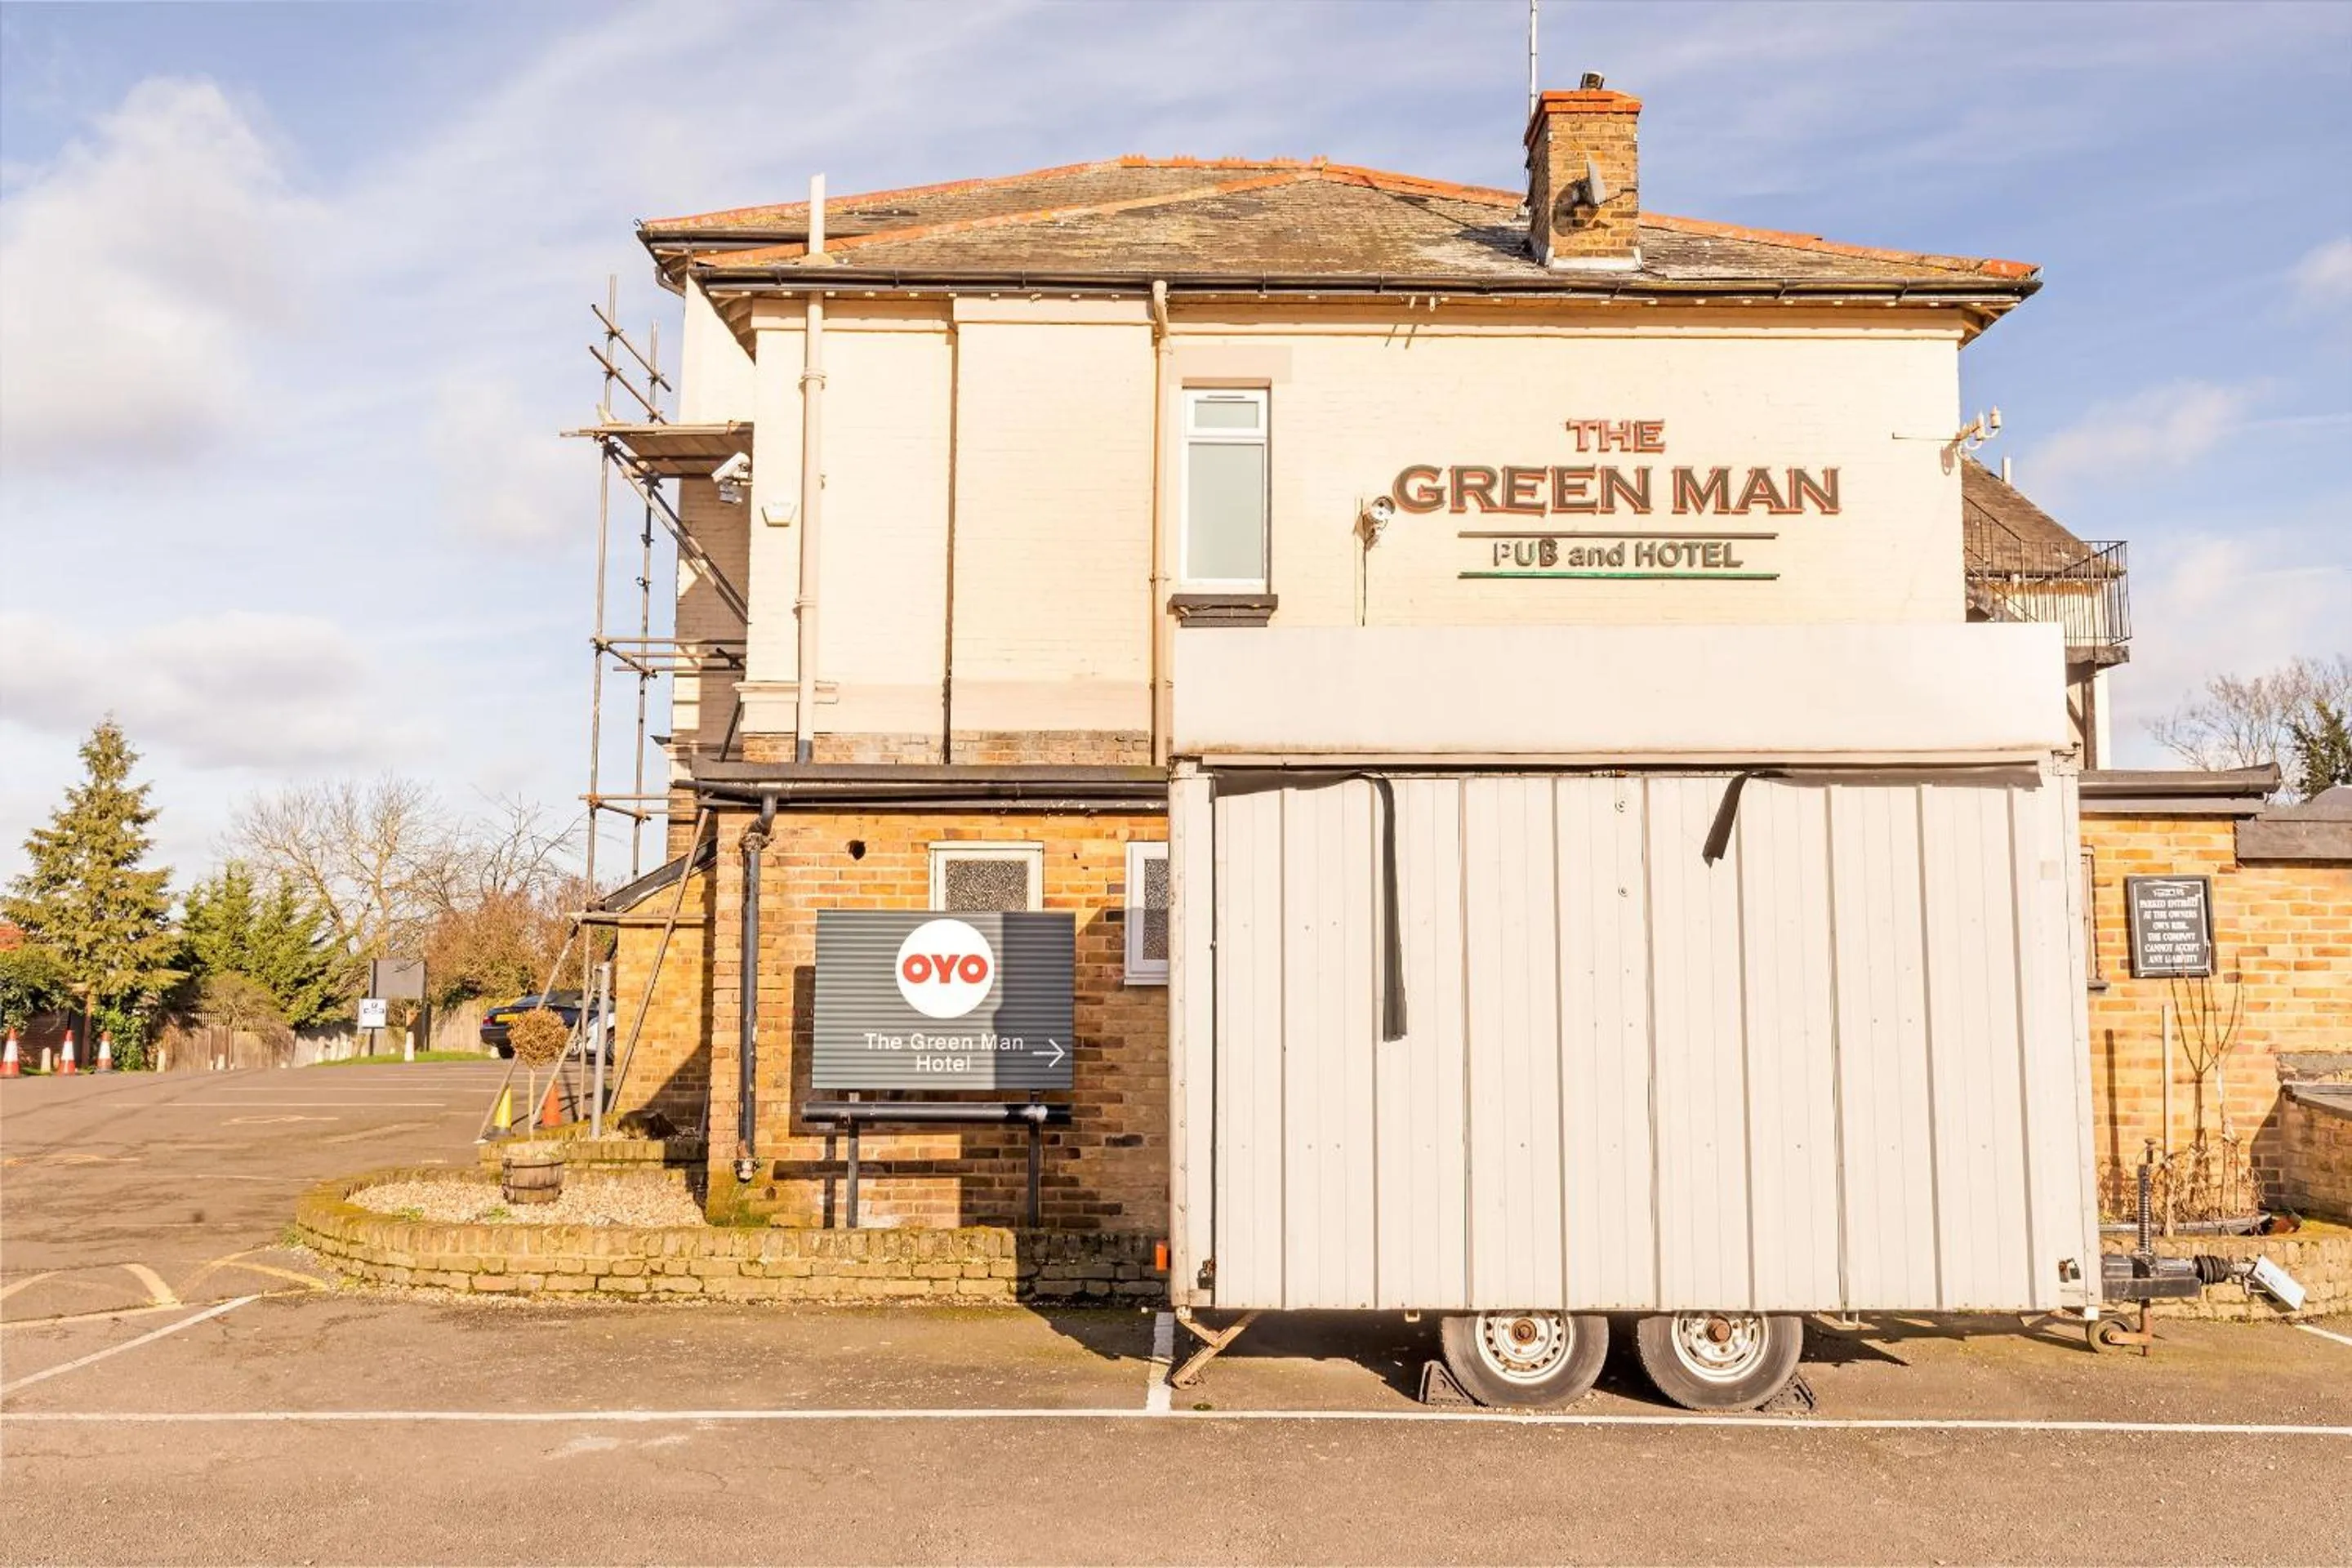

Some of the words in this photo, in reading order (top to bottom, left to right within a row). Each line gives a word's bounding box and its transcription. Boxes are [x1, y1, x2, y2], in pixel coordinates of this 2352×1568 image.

[1566, 418, 1666, 454] THE
[1392, 464, 1655, 517] GREEN
[1671, 465, 1842, 515] MAN
[1493, 539, 1559, 568] PUB
[1569, 541, 1626, 568] and
[1635, 541, 1744, 569] HOTEL
[2153, 911, 2167, 920] THE
[2148, 933, 2162, 942] THE
[2163, 933, 2196, 942] COMPANY
[2145, 943, 2173, 952] CANNOT
[2175, 943, 2200, 952] ACCEPT
[2149, 954, 2163, 963] ANY
[902, 953, 988, 984] OYO
[863, 1032, 902, 1050] The
[910, 1032, 973, 1050] Green
[980, 1033, 1024, 1050] Man
[916, 1054, 971, 1072] Hotel
